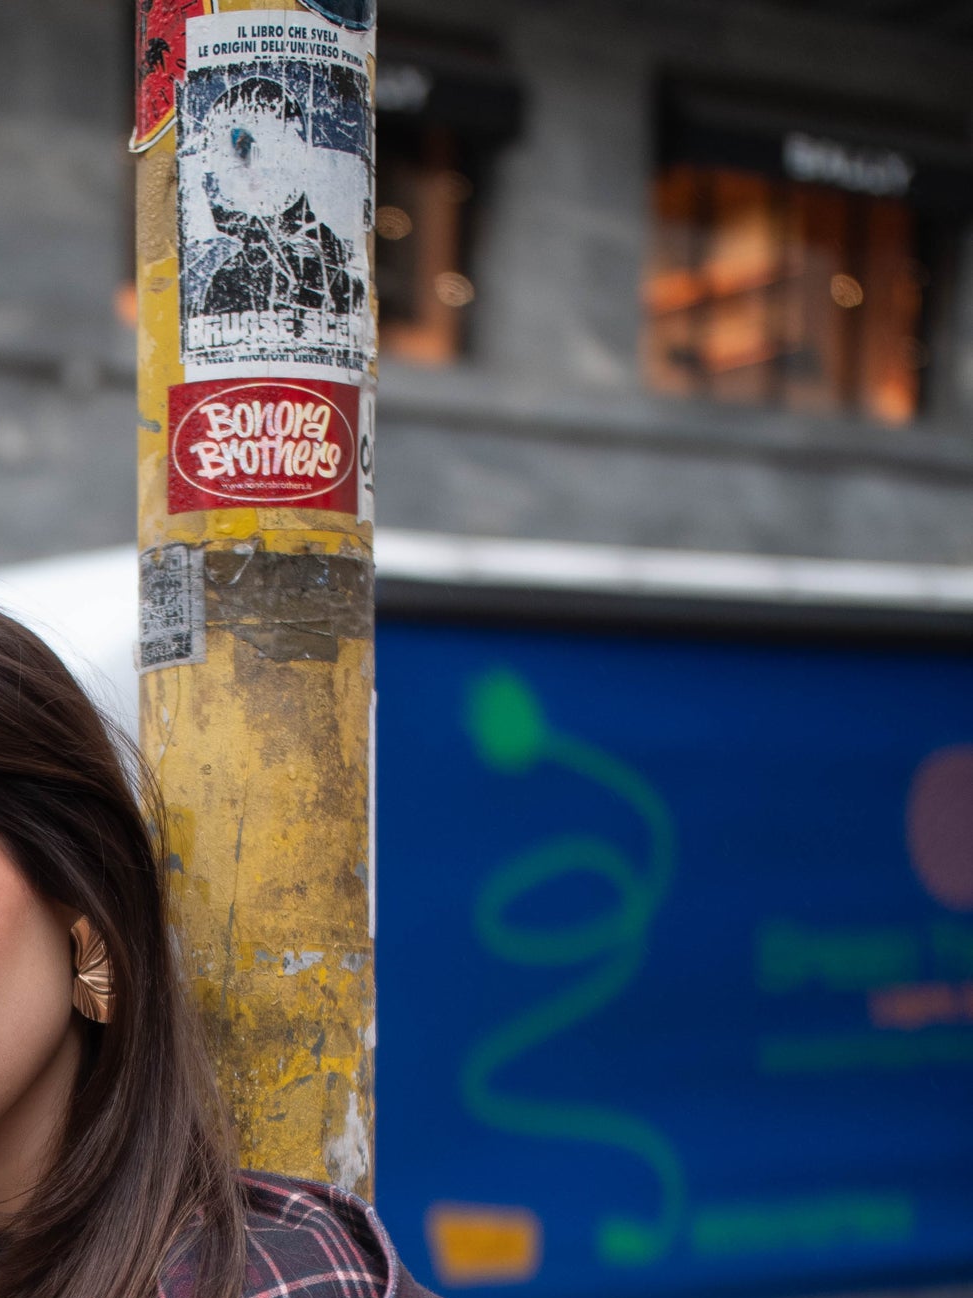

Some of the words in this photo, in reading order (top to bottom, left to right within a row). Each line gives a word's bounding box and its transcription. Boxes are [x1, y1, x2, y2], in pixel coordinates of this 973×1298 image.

[237, 26, 248, 39] IL
[251, 25, 284, 38] LIBRO
[288, 26, 307, 40] CHE
[311, 28, 339, 43] SVELA
[198, 45, 209, 58] LE
[212, 41, 257, 56] ORIGINI
[341, 50, 364, 69] PRIMA
[189, 436, 341, 479] Brothers
